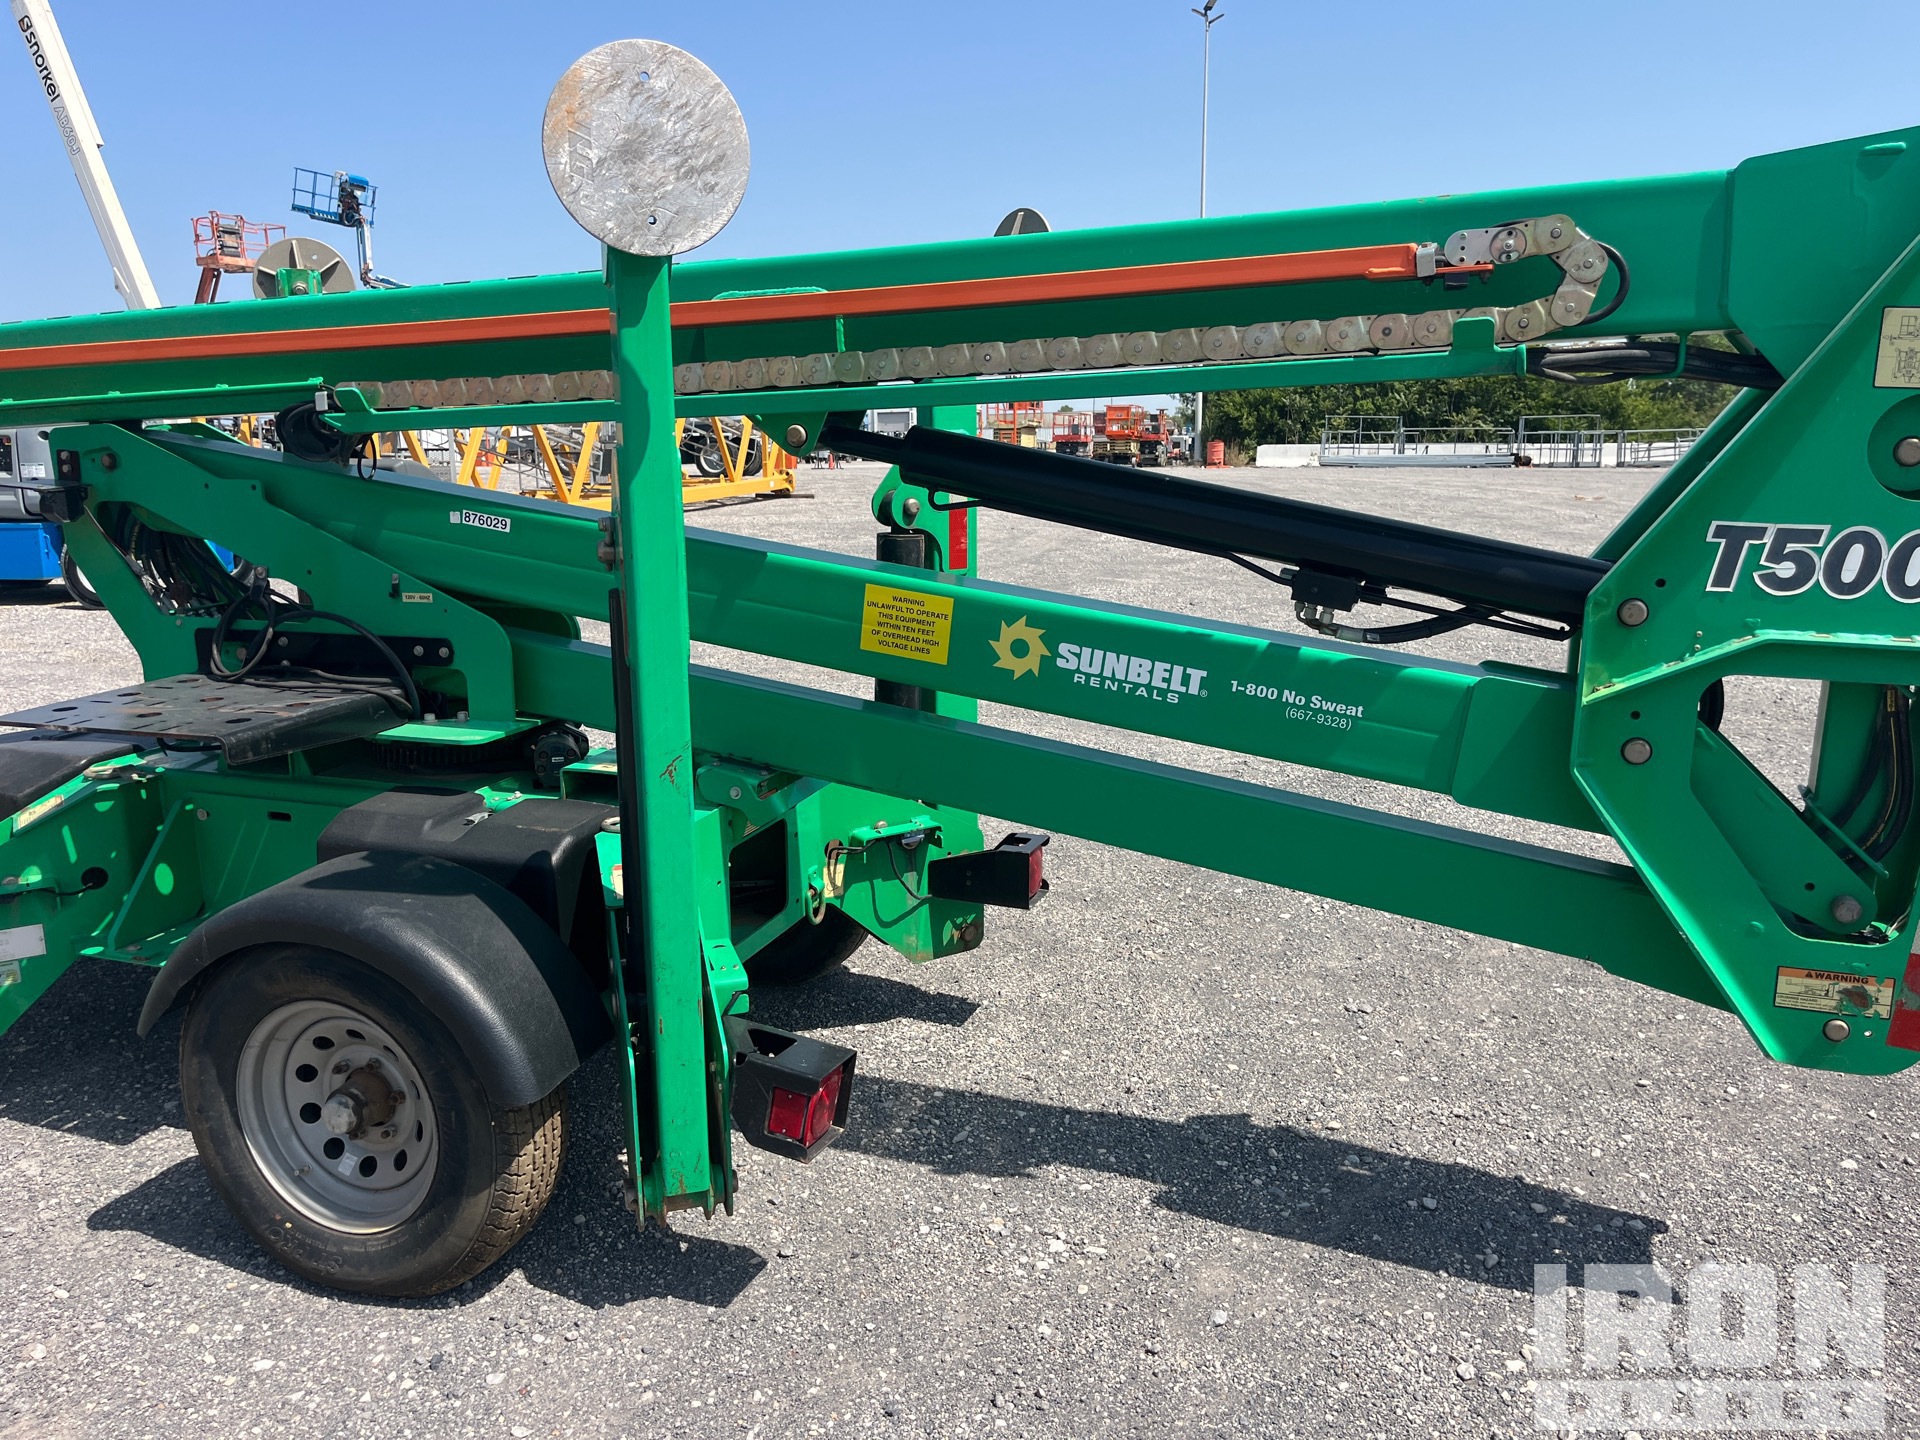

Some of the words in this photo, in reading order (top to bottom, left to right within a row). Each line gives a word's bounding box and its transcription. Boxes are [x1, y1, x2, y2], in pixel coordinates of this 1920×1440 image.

[25, 31, 61, 103] snorkel
[53, 106, 81, 156] AB60J
[464, 511, 507, 530] 876029
[867, 600, 905, 613] UNLAWFUL
[906, 607, 915, 615] TO
[916, 609, 949, 621] OPERATE
[892, 595, 925, 607] WARNING
[877, 620, 901, 631] WITHIN
[902, 625, 916, 634] TEN
[917, 627, 936, 637] FEET
[878, 611, 894, 620] THIS
[895, 614, 936, 628] EQUIPMENT
[871, 628, 881, 636] OF
[882, 630, 921, 644] OVERHEAD
[921, 638, 940, 647] HIGH
[878, 639, 908, 651] VOLTAGE
[910, 645, 931, 655] LINES
[1073, 672, 1179, 704] RENTALS
[1230, 680, 1278, 700] 1-800
[1281, 689, 1306, 706] No
[1309, 695, 1364, 718] Sweat
[1285, 706, 1352, 731] (667-9328)
[1814, 971, 1869, 985] WARNING
